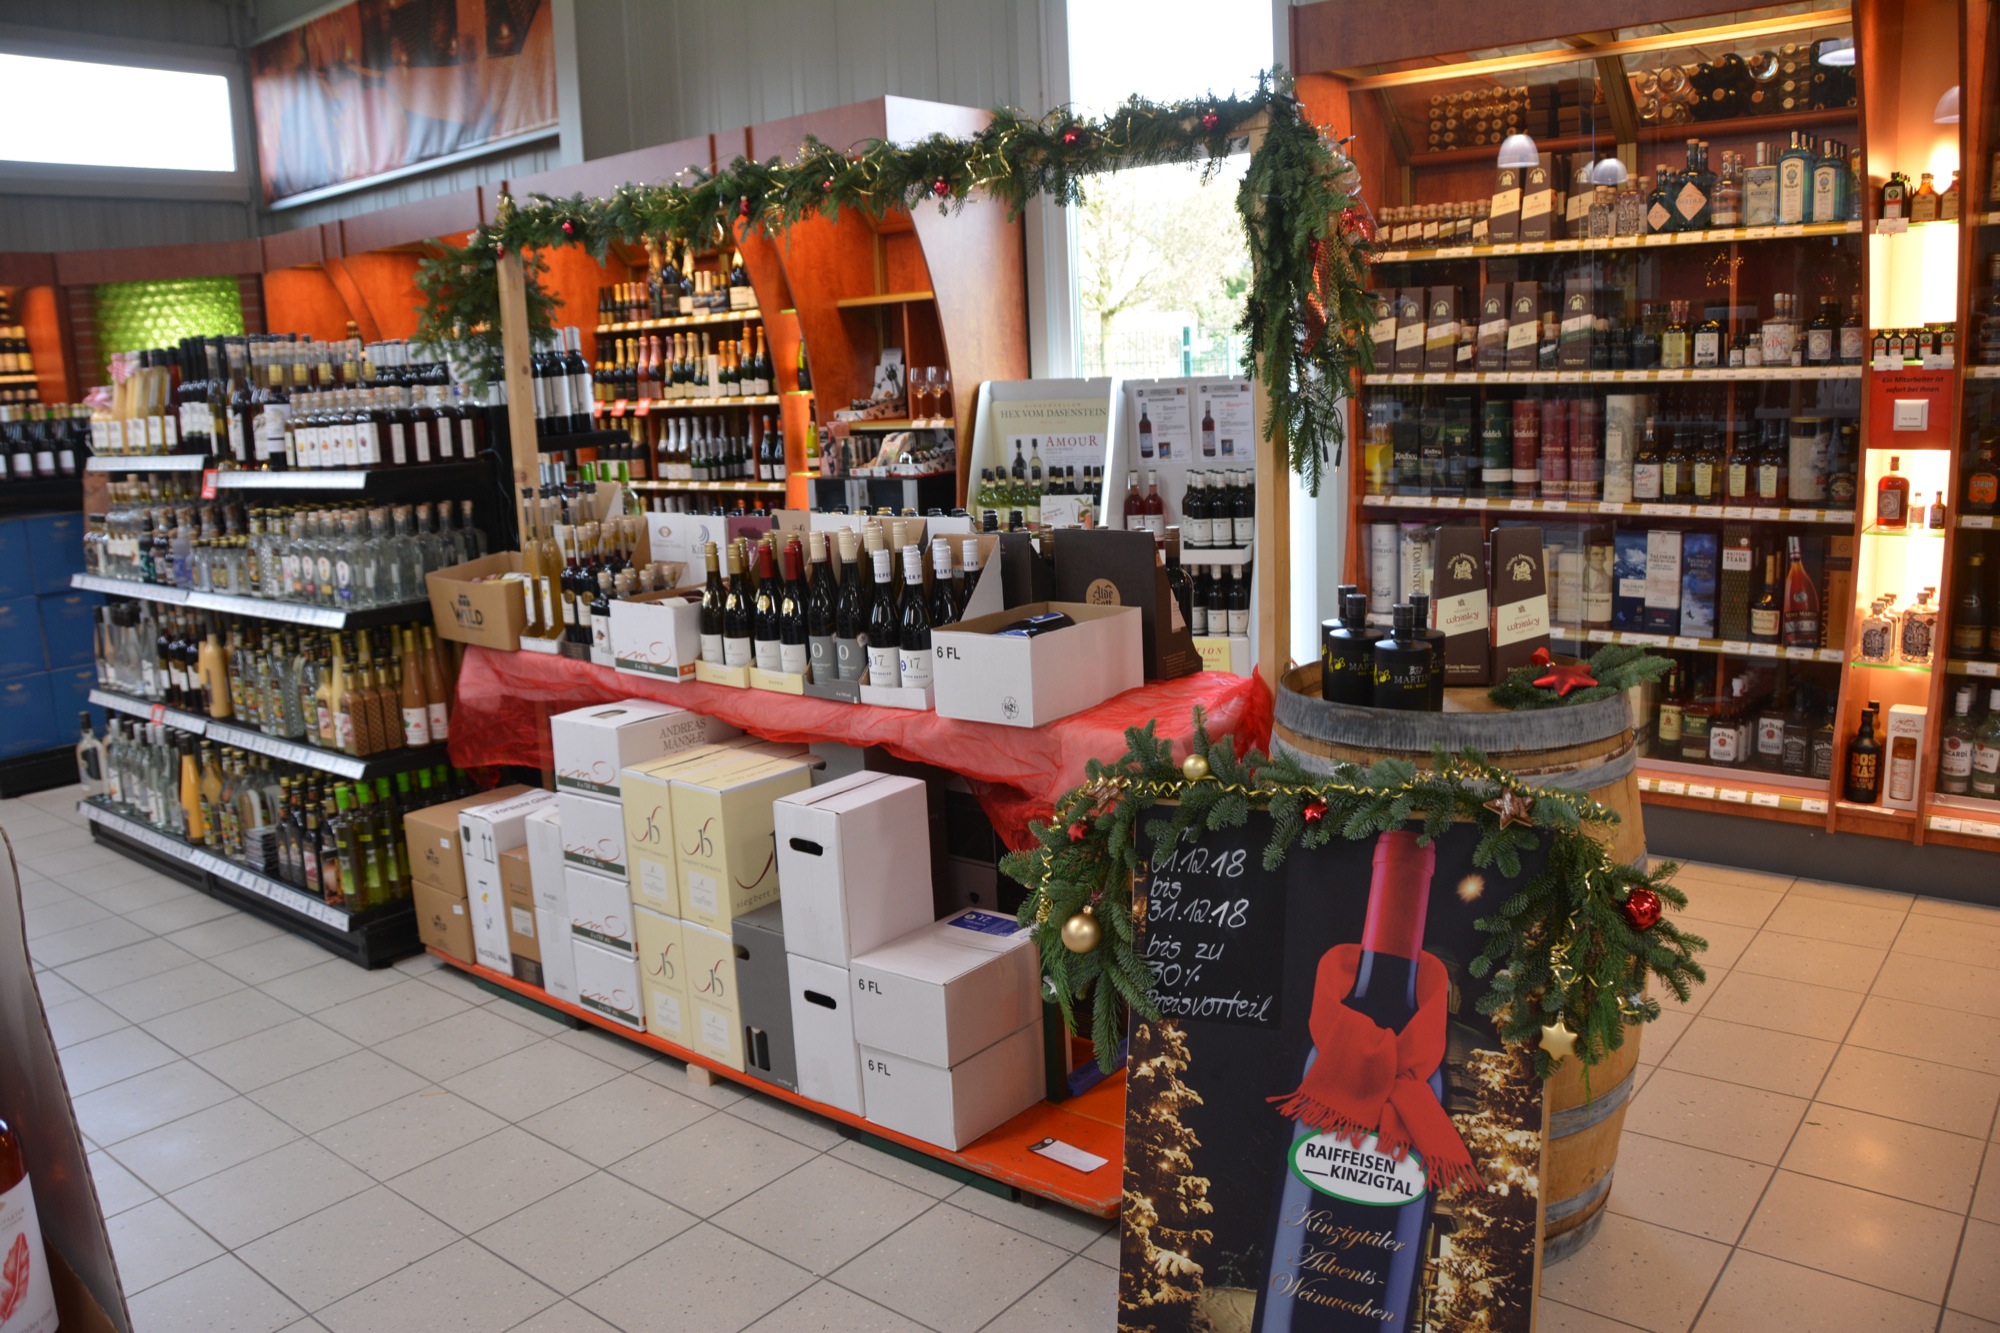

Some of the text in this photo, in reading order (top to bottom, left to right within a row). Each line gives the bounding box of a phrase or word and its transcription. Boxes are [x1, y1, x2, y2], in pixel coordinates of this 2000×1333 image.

[1886, 386, 1906, 394] sofort
[1001, 408, 1106, 418] HEX VOM DASENSTEIN
[1046, 435, 1098, 447] AMOUR
[1412, 544, 1422, 592] TOMINTO
[450, 601, 484, 626] WILD
[1446, 610, 1480, 624] whisky
[1506, 617, 1540, 632] whisky
[936, 646, 961, 660] 6 FL
[659, 718, 707, 740] ANDREAS
[1852, 752, 1876, 766] DOS
[1150, 876, 1182, 900] bis
[1148, 898, 1249, 928] 31.12.18
[1146, 934, 1224, 960] bis zu
[858, 978, 882, 995] 6 FL
[868, 1060, 891, 1077] 6 FL
[1305, 1143, 1396, 1174] RAIFFEISEN
[1330, 1164, 1414, 1196] KINZIGTAL
[1282, 1202, 1406, 1252] Kinzigtäler
[1287, 1243, 1386, 1285] Advents-
[1269, 1270, 1396, 1322] Weinwochen
